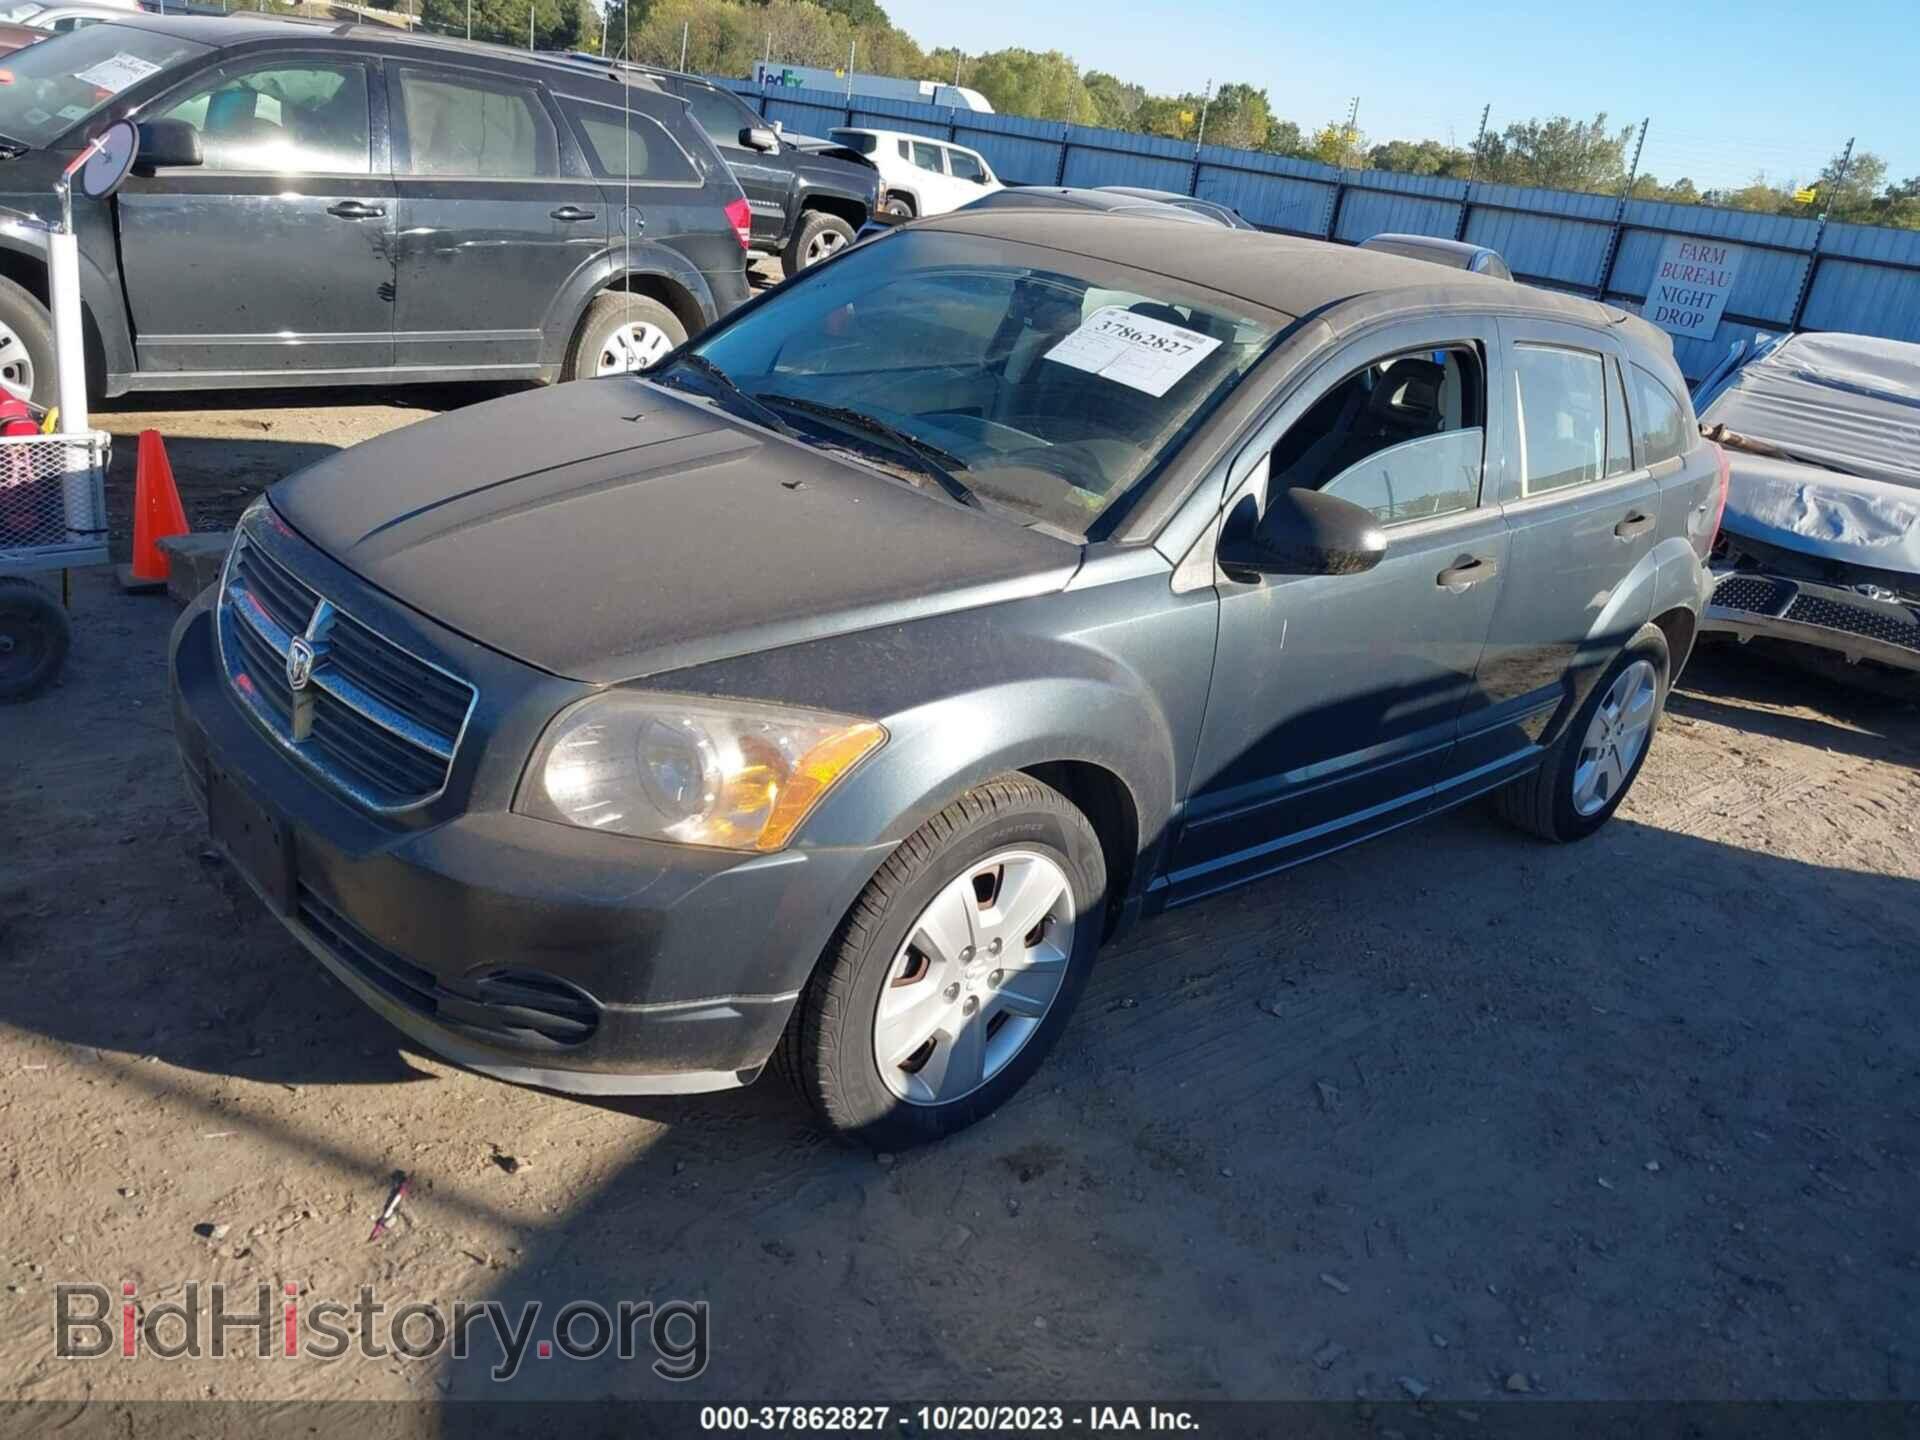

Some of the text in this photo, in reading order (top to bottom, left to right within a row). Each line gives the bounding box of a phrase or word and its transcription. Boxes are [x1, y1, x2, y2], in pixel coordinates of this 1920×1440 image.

[1680, 243, 1727, 265] FARM
[1661, 262, 1732, 288] BUREAU
[1657, 285, 1717, 309] NIGHT
[1655, 306, 1705, 328] DROP
[1095, 320, 1193, 356] 37862827
